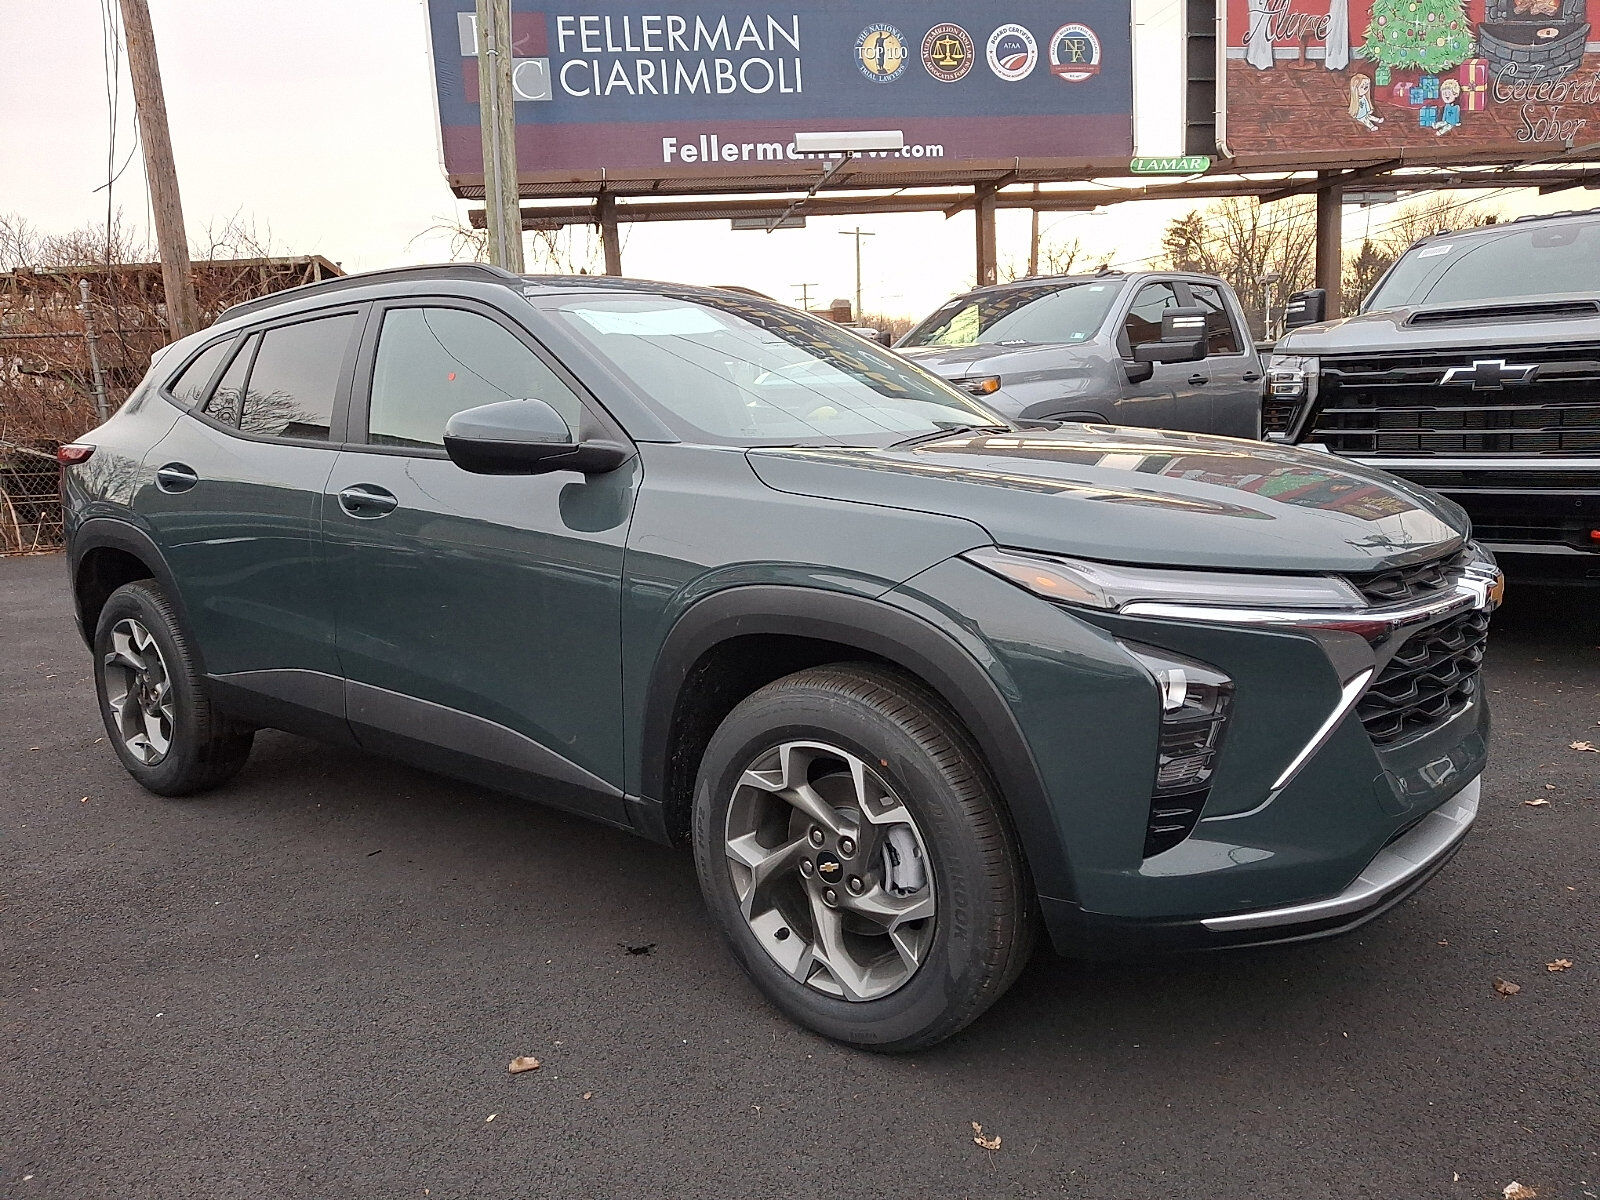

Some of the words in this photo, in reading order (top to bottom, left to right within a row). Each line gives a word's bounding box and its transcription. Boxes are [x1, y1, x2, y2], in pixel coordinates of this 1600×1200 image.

[556, 14, 800, 53] FELLERMAN
[857, 30, 870, 45] THE
[869, 24, 904, 43] NATIONAL
[990, 28, 1008, 45] BOARD
[1008, 26, 1033, 45] CERTIFIED
[855, 46, 884, 59] TOP
[887, 47, 908, 59] 100
[512, 60, 546, 99] C
[559, 58, 802, 97] CIARIMBOLI
[860, 65, 877, 80] TRIAL
[879, 65, 905, 81] LAWYERS
[953, 61, 971, 79] FORUM
[1516, 103, 1587, 143] Sober
[1137, 158, 1201, 170] LAMAR
[986, 266, 995, 281] 4
